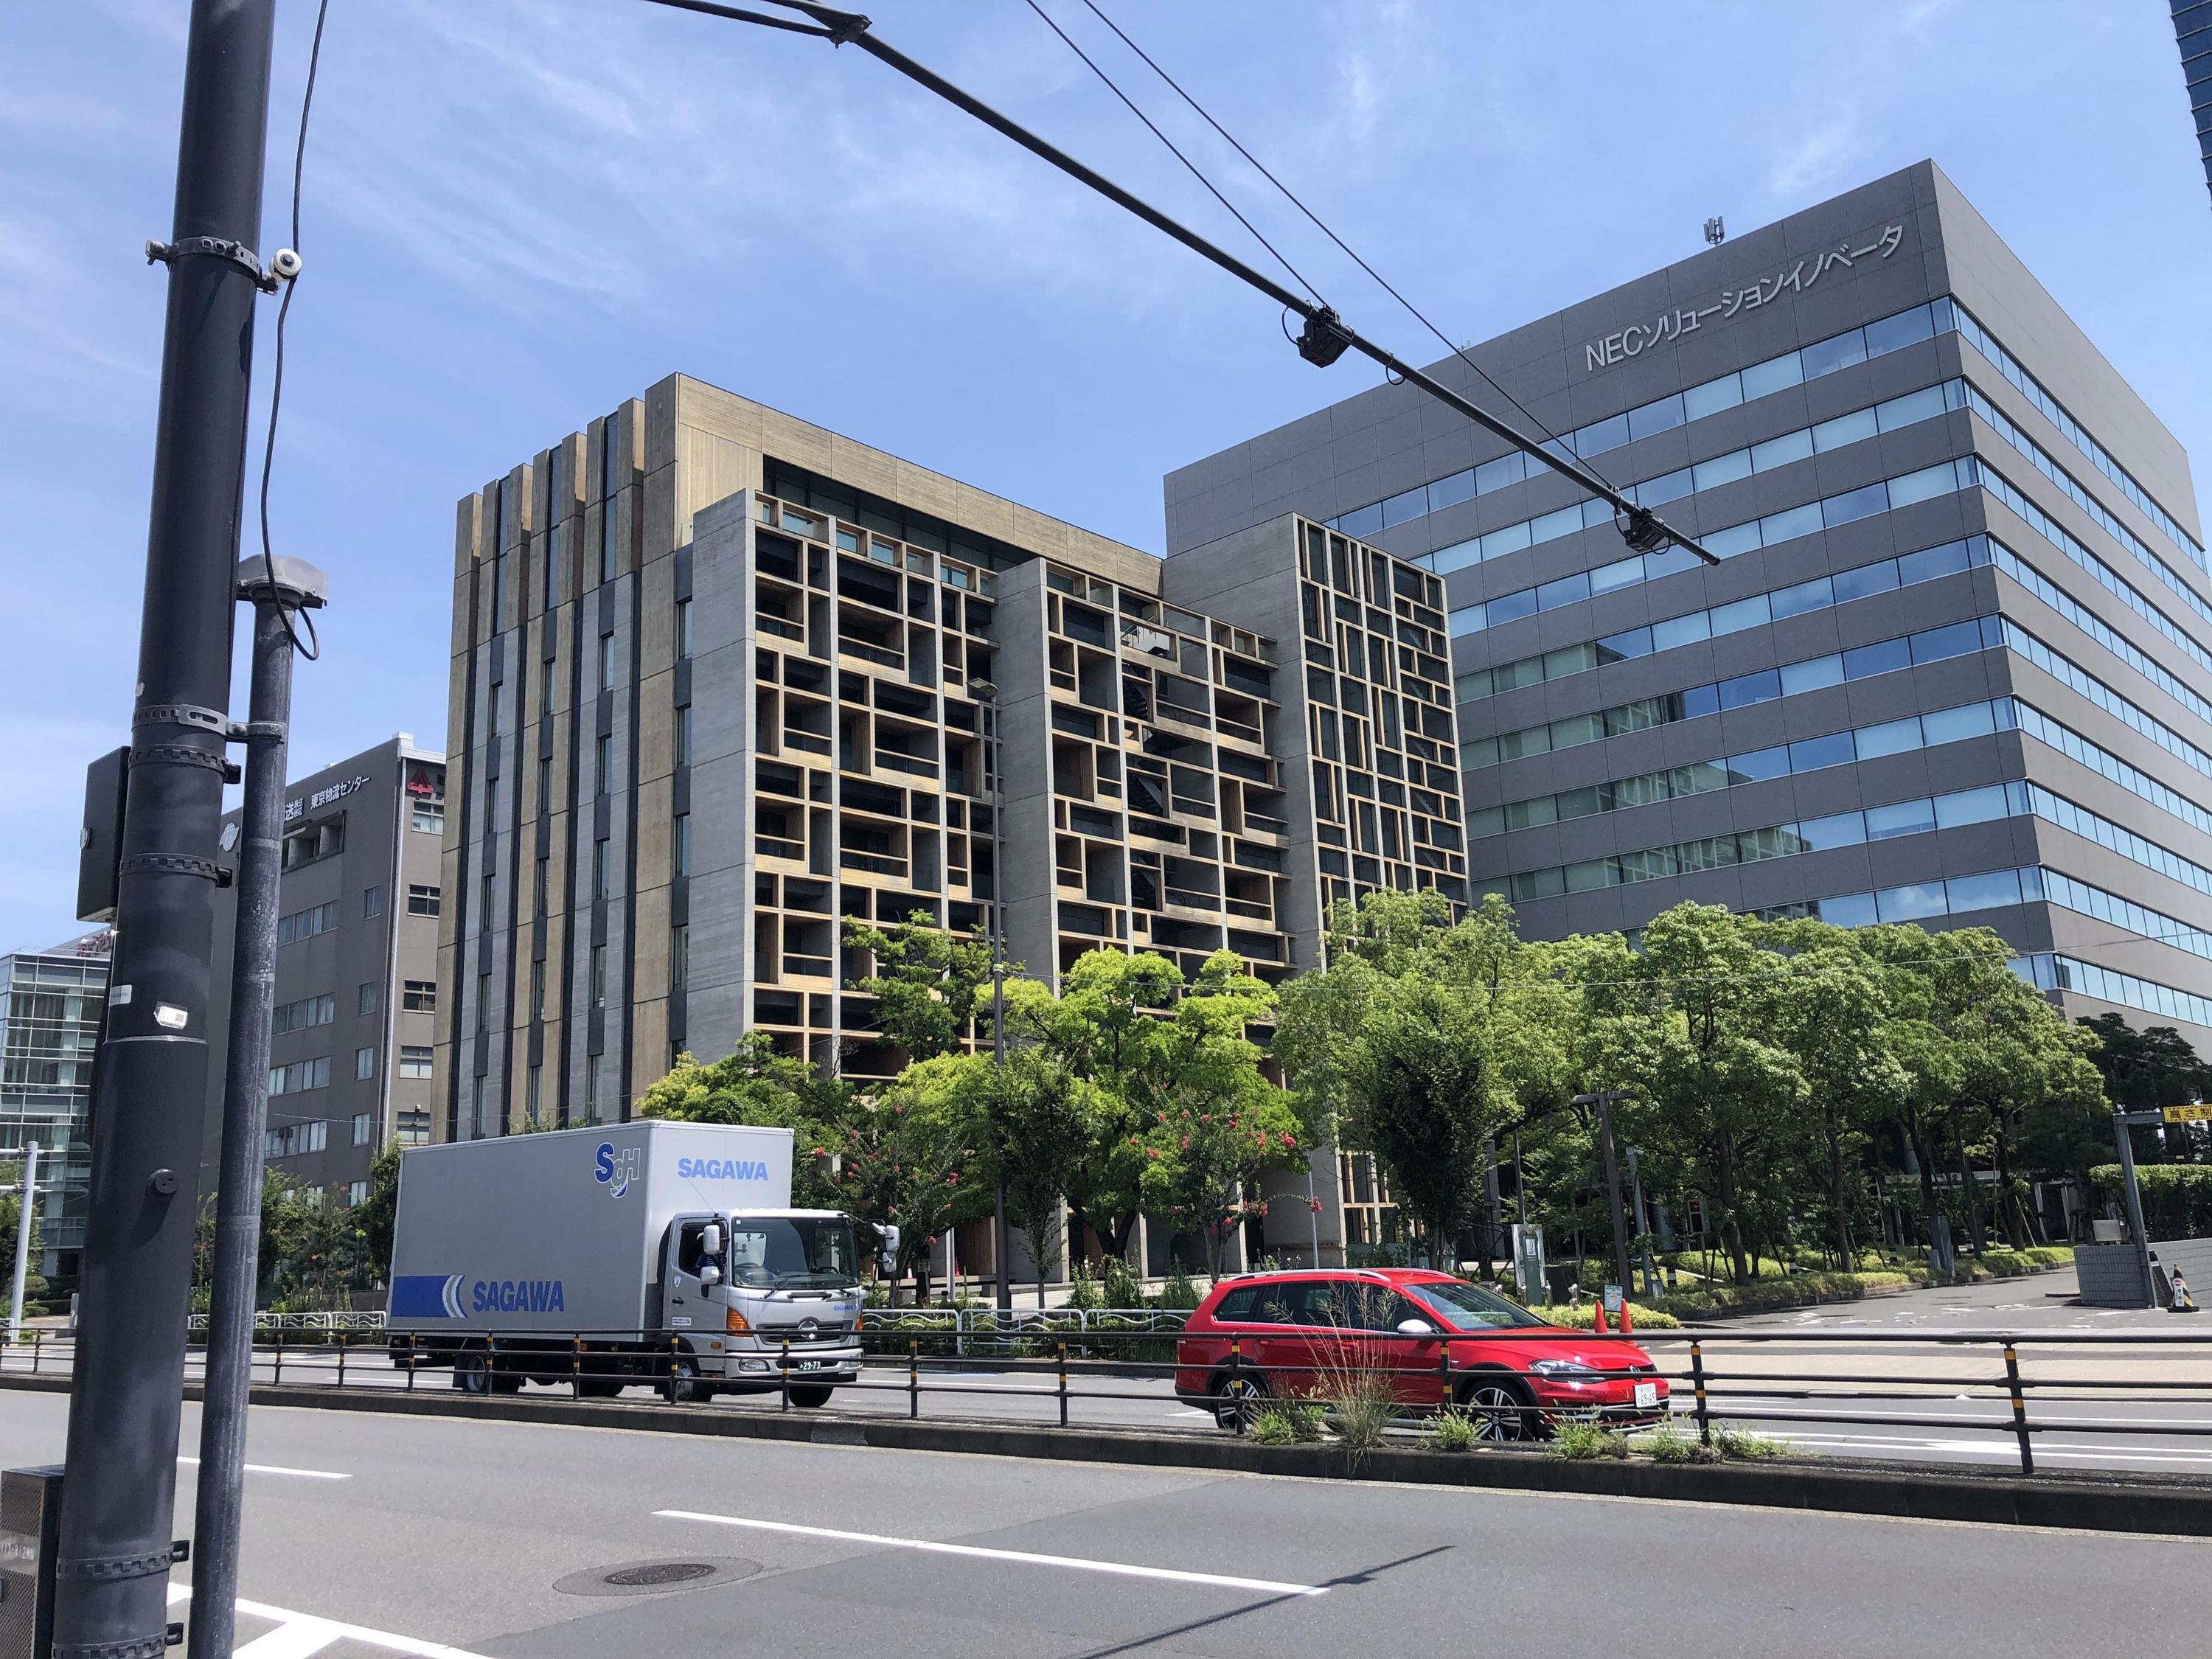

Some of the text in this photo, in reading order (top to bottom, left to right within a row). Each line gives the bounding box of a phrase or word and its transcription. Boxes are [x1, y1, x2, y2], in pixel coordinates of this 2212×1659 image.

[1585, 225, 1903, 371] NECソリューションイノベータ
[310, 775, 370, 810] 東京物流センター
[678, 1158, 768, 1180] SAGAWA
[473, 1280, 565, 1312] SAGAWA
